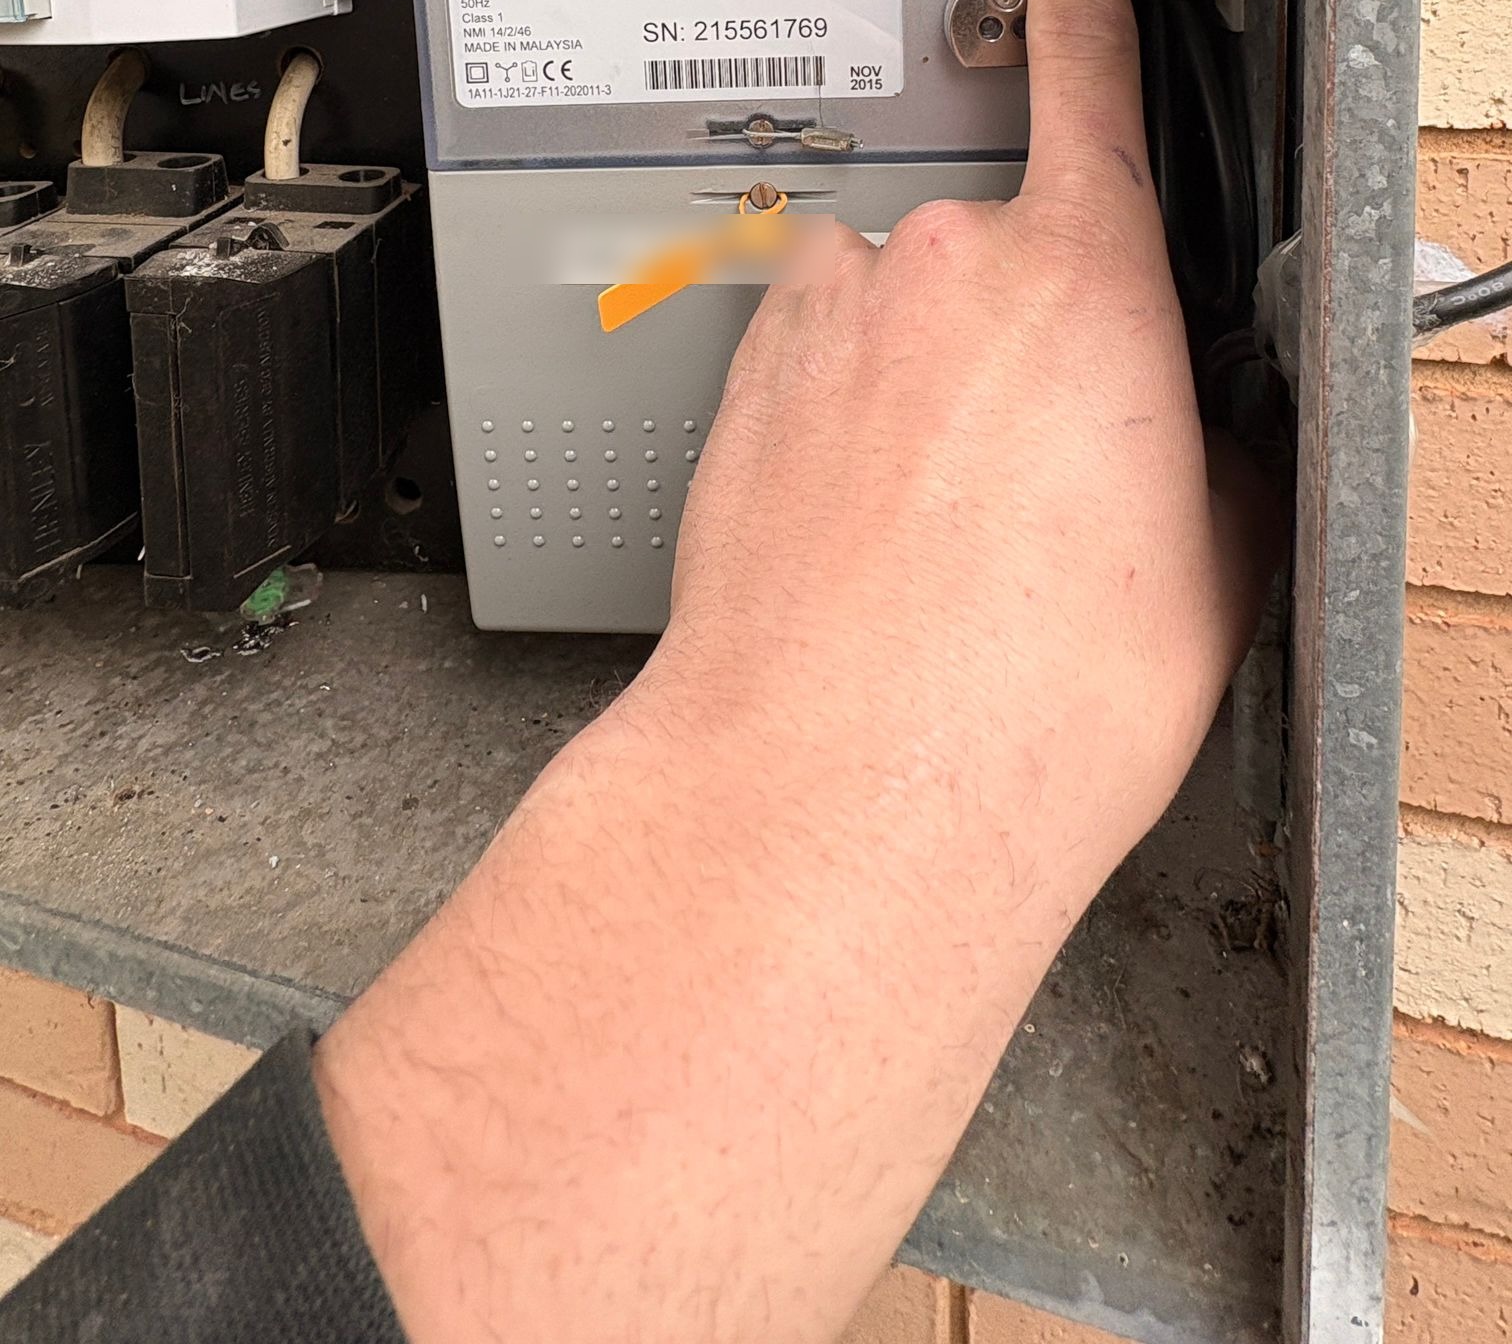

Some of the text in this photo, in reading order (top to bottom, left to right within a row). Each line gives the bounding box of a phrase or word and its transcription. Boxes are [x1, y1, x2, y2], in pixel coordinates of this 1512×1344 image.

[462, 12, 503, 24] Class 1
[463, 26, 531, 38] NMI 14/2/46
[643, 17, 828, 42] SN: 215561769
[464, 39, 583, 53] MADE IN MALAYSIA
[850, 66, 882, 78] NOV
[850, 78, 883, 90] 2015
[180, 80, 260, 105] LINES
[468, 85, 612, 100] 1A11-1J21-27-F11-202011-3
